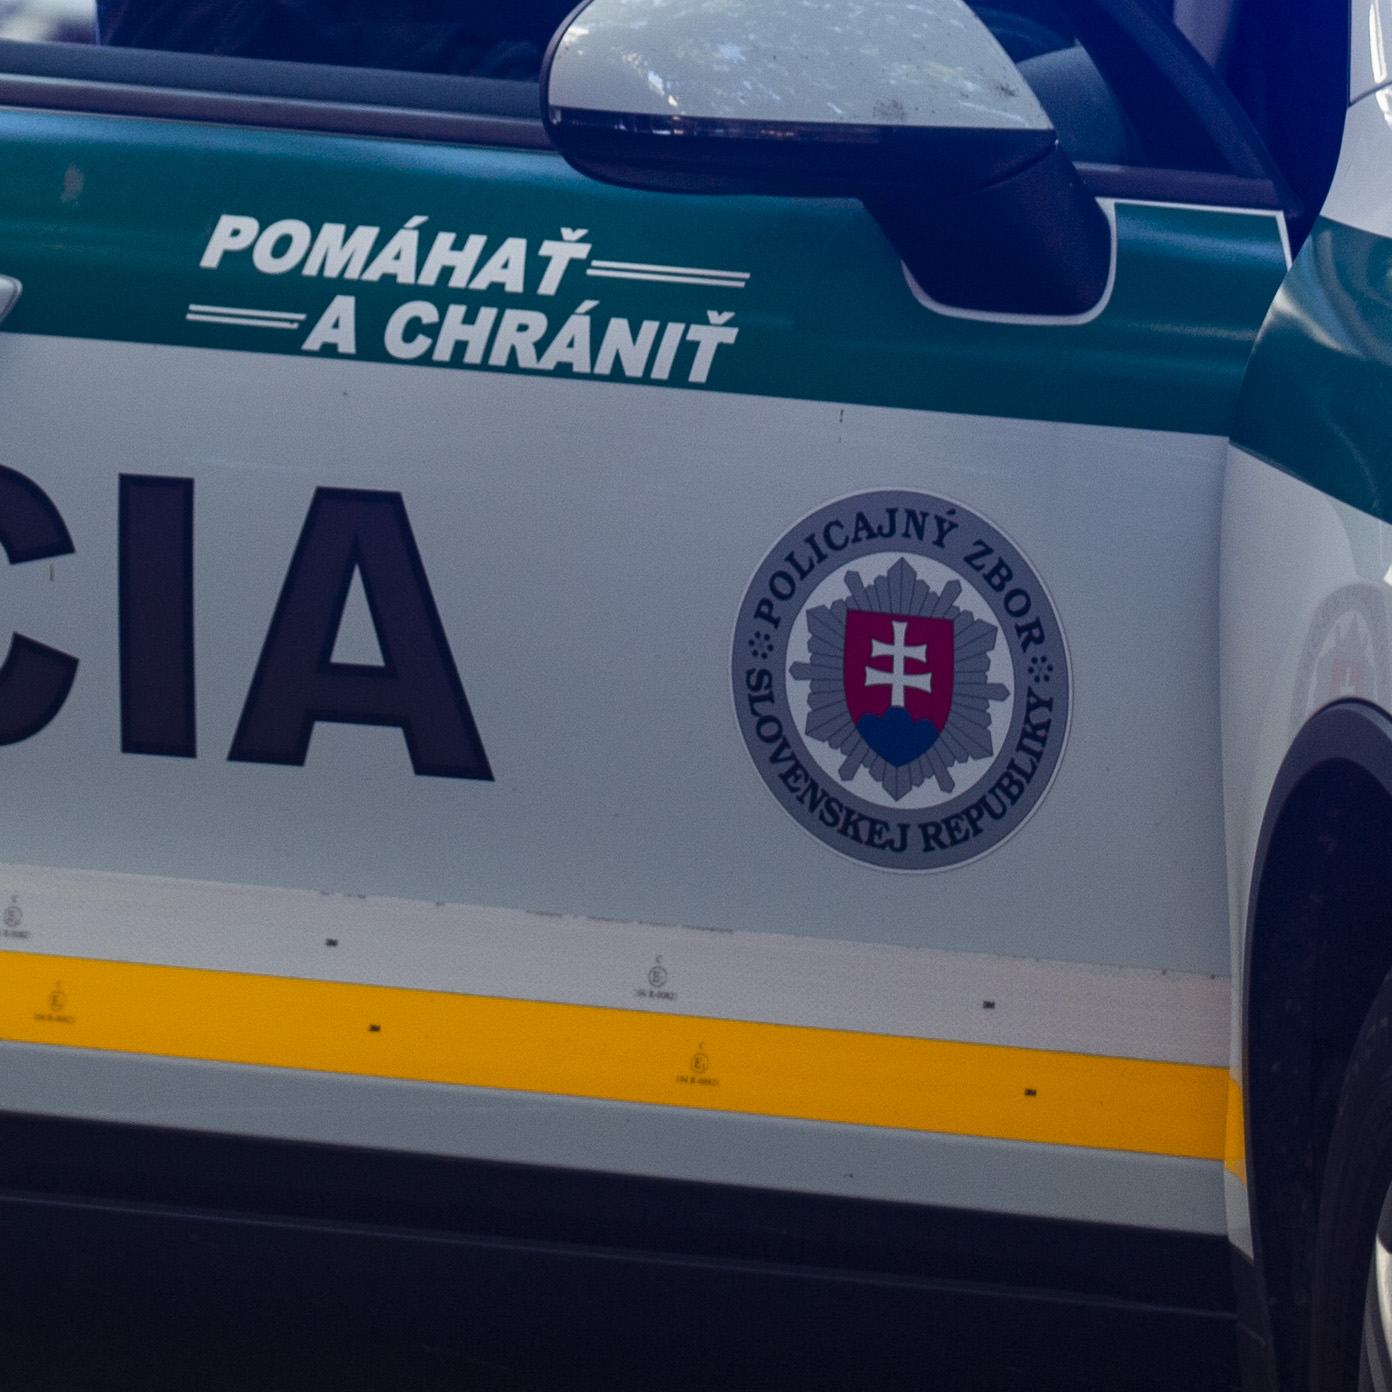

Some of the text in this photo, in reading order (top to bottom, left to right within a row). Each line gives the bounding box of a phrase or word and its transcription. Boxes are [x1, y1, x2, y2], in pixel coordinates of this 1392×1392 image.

[200, 214, 592, 296] POMÁHAŤ
[302, 295, 739, 384] A CHRÁNIŤ
[753, 507, 1046, 654] POLICAJNÝ ZBOR
[744, 667, 1054, 853] SLOVENSKEJ REPUBLIKY
